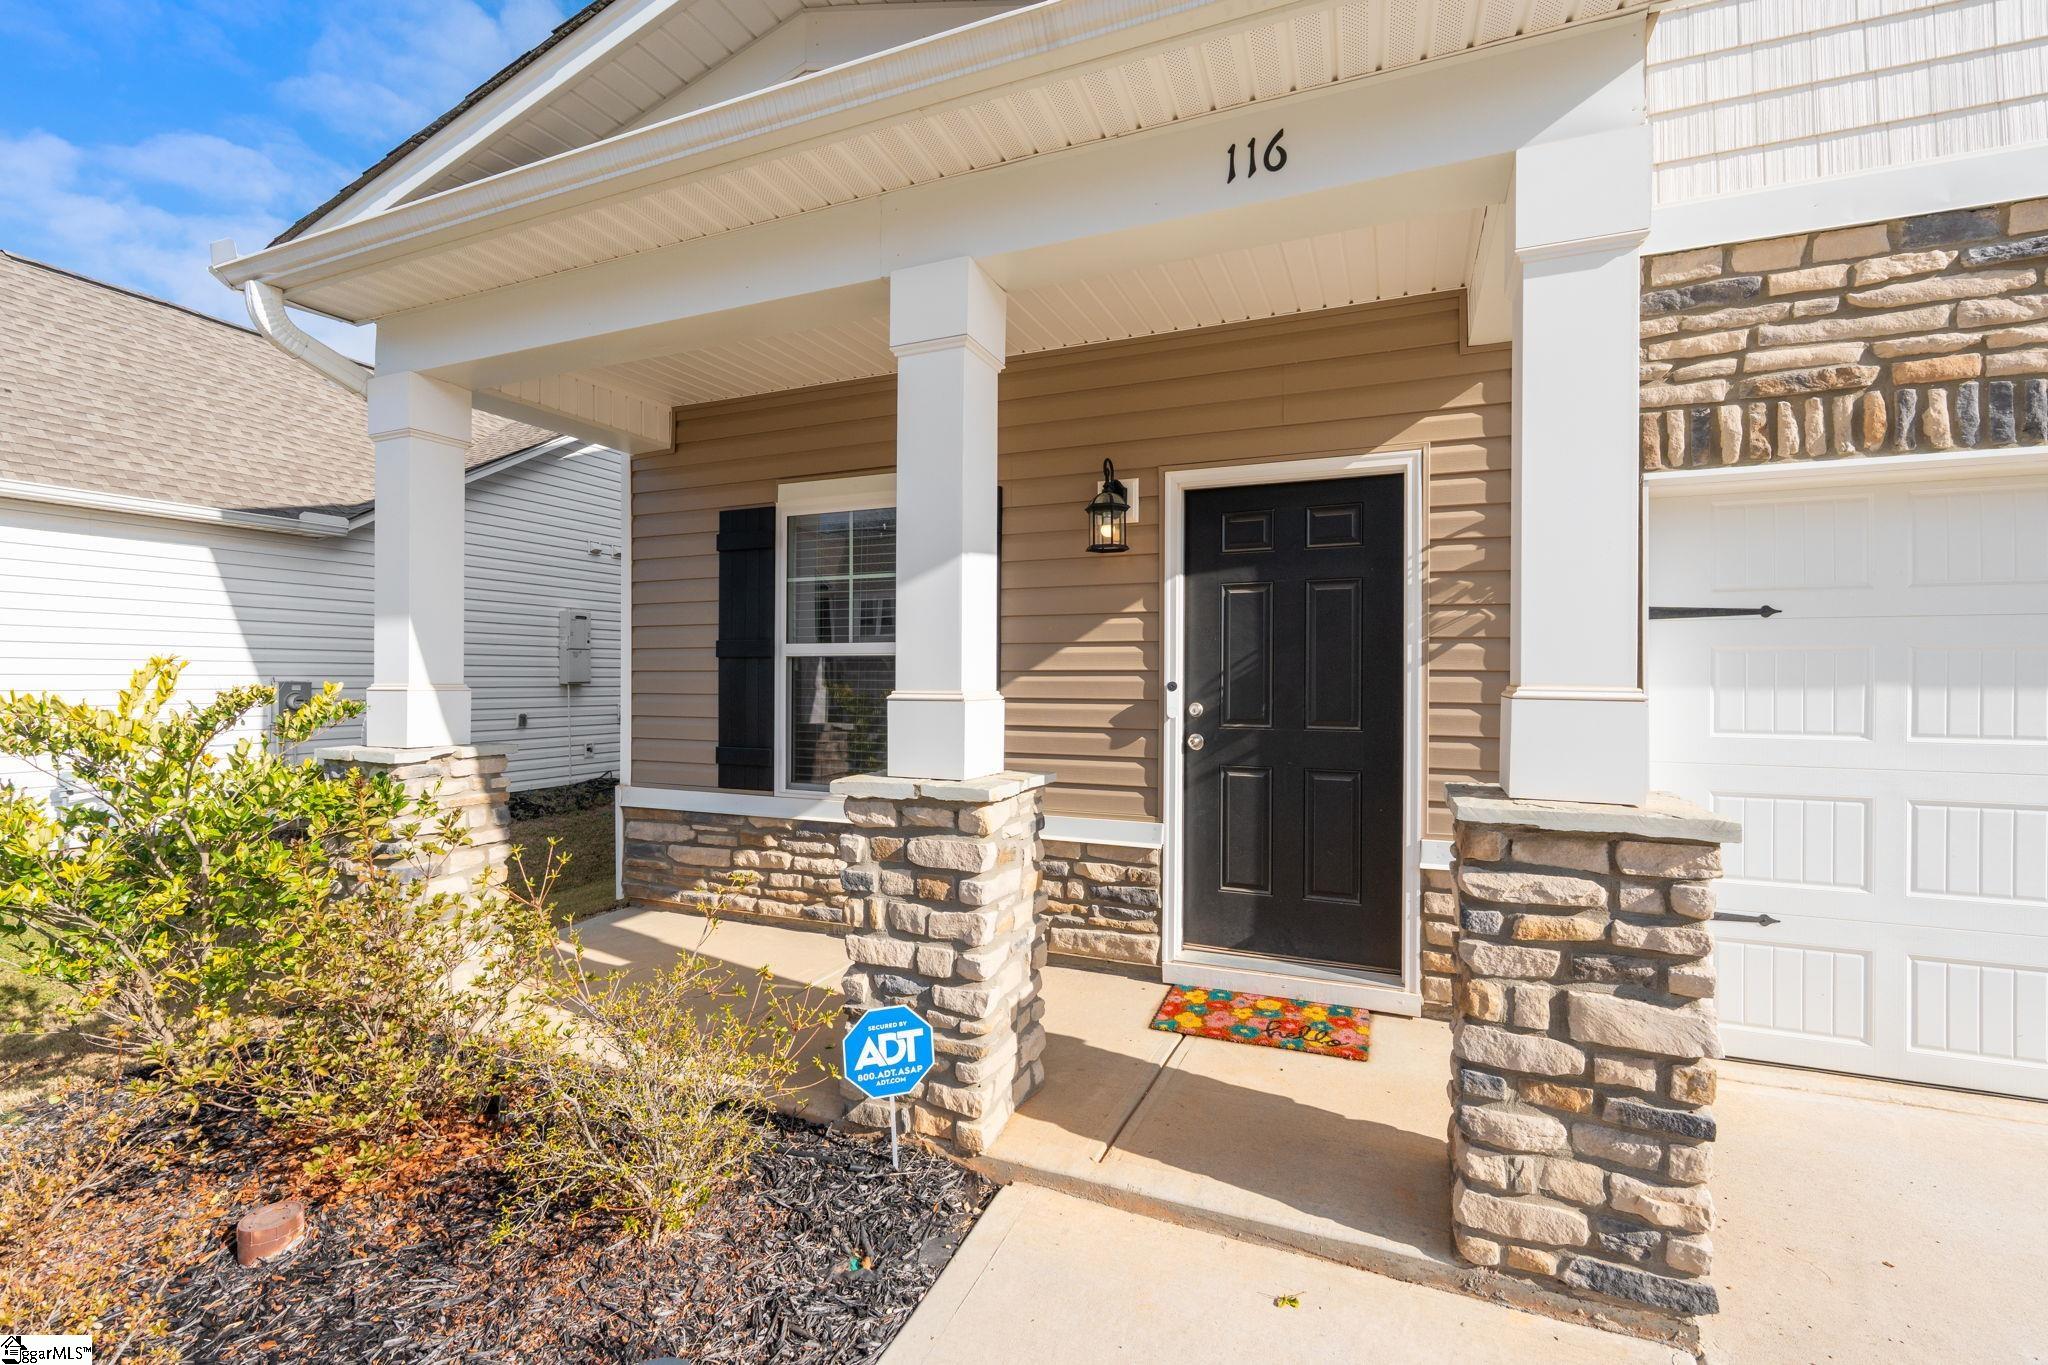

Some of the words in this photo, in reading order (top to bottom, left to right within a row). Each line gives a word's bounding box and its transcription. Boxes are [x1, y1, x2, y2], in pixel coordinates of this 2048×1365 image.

[1227, 128, 1287, 184] 116
[868, 1022, 897, 1031] SECURED
[1263, 1020, 1350, 1047] hello
[854, 1028, 923, 1071] ADT
[857, 1065, 923, 1082] 800.ADT.ASAP
[875, 1077, 906, 1086] ADT.COM
